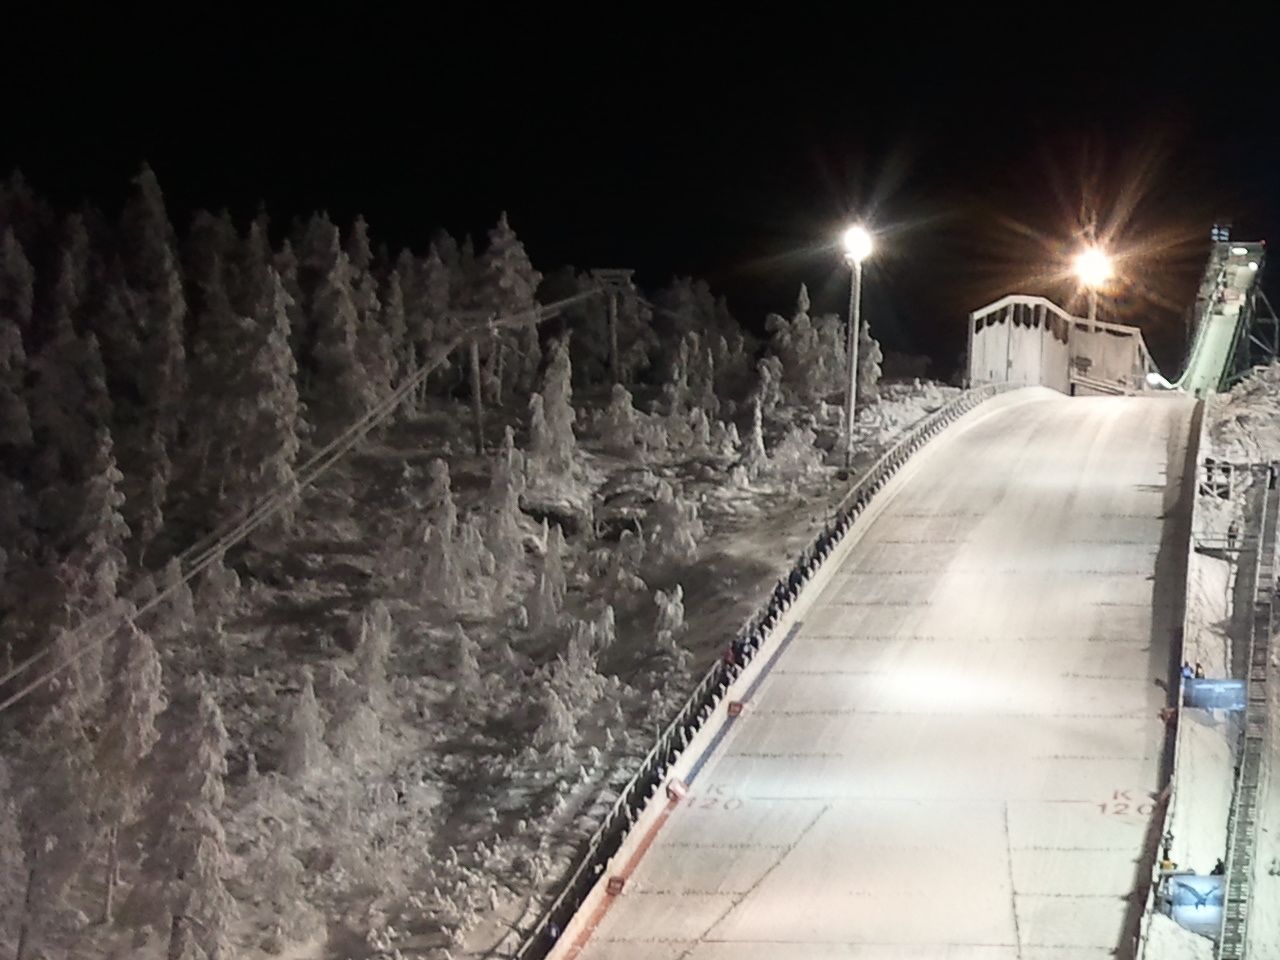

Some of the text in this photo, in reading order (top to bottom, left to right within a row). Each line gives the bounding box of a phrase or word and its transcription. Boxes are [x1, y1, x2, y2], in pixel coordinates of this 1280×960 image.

[1113, 789, 1133, 801] K
[687, 797, 743, 812] 120
[1097, 802, 1156, 816] 120
